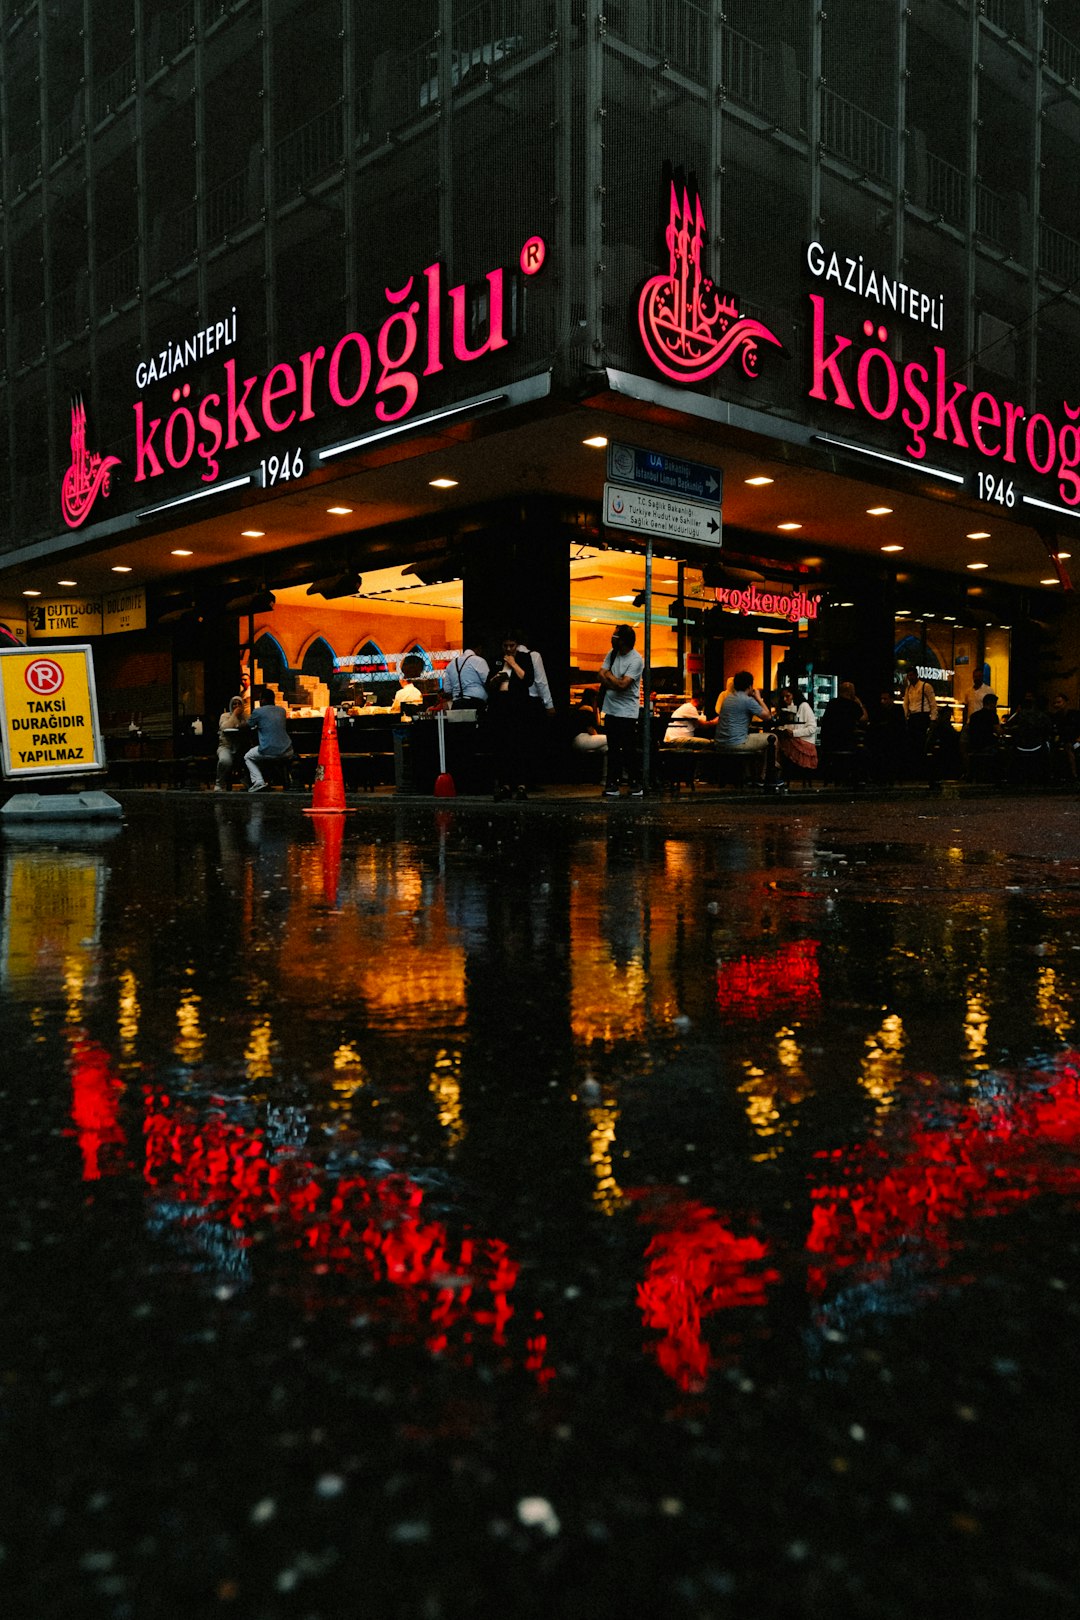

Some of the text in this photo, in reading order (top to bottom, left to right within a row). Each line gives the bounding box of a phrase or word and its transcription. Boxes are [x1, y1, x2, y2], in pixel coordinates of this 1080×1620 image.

[807, 242, 944, 331] GAZİANTEPLİ
[136, 307, 237, 388] GAZİANTEPLİ
[133, 263, 508, 482] köşkeroğlu
[260, 448, 304, 488] 1946
[978, 472, 1015, 508] 1946
[47, 603, 101, 616] OUTDOOR
[48, 617, 79, 629] TIME
[27, 697, 66, 713] TAKSİ
[12, 714, 85, 731] DURAĞIDIR
[32, 732, 67, 746] PARK
[18, 748, 84, 763] YAPILMAZ
